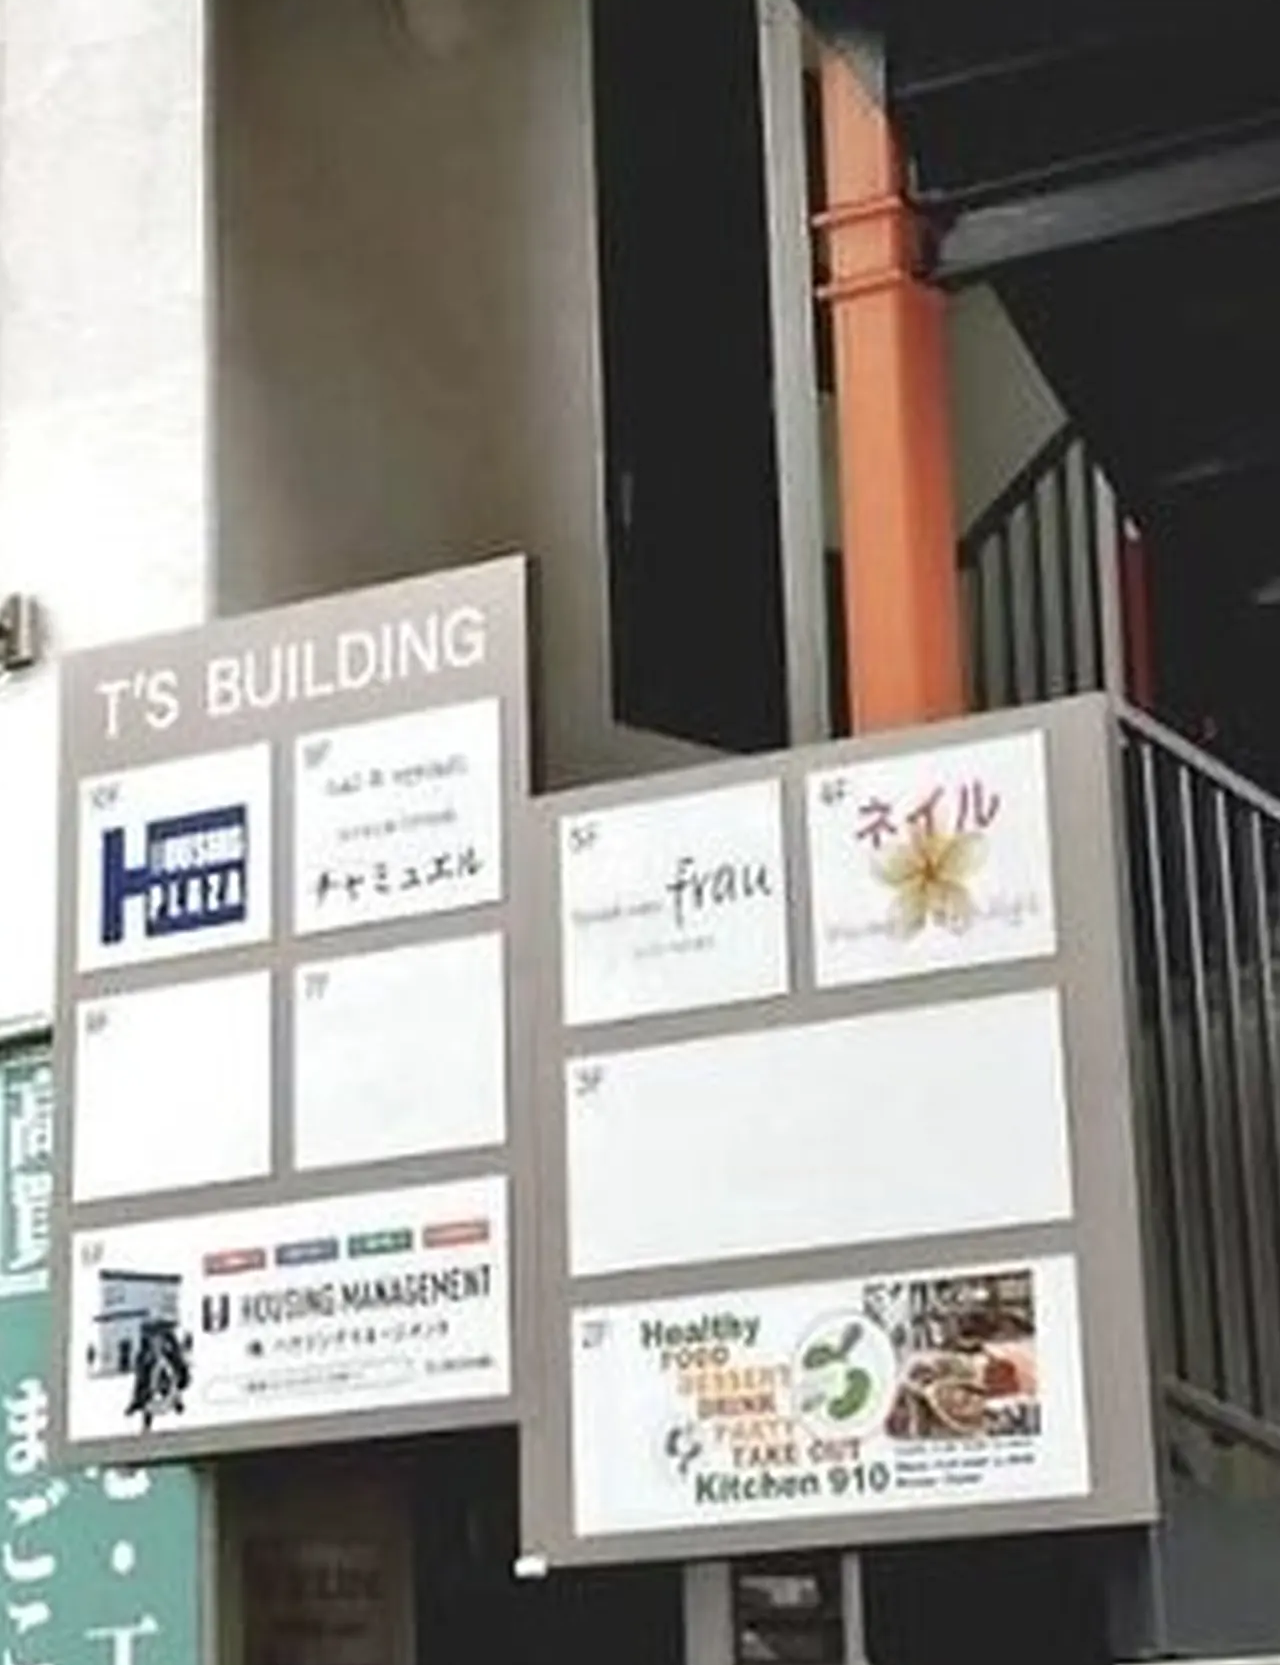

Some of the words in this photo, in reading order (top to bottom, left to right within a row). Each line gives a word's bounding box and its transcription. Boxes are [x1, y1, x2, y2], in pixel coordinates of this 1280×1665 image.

[96, 668, 179, 740] T'S
[206, 606, 487, 717] BUILDING
[855, 777, 1001, 850] ネイル
[666, 856, 773, 930] frau
[240, 1282, 334, 1326] HOUSING
[341, 1264, 492, 1313] MANAGEMENT
[639, 1311, 761, 1349] Healthy
[660, 1347, 730, 1371] FOOD
[696, 1392, 776, 1420] DRINK
[730, 1443, 796, 1469] TAKE
[807, 1437, 862, 1463] OUT
[694, 1468, 820, 1506] Kitchen
[828, 1462, 891, 1496] 910
